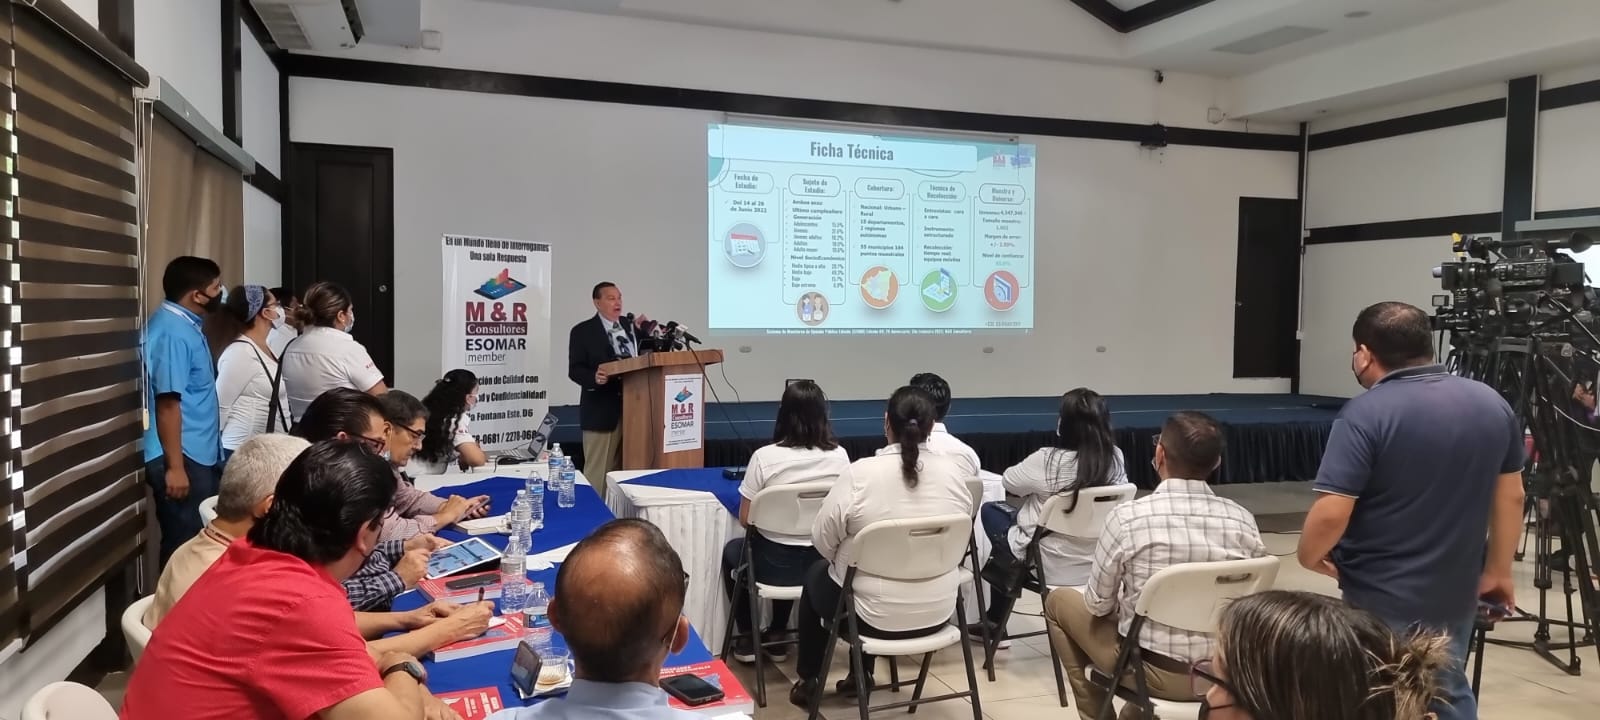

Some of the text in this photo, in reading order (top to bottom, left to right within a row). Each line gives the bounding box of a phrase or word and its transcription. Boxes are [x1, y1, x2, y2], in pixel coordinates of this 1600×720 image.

[810, 141, 894, 161] Ficha Técnica
[734, 173, 759, 182] Fecha de
[803, 178, 820, 186] Sujeto
[735, 181, 757, 189] Estudio:
[867, 184, 894, 192] Cobertura:
[454, 237, 463, 247] un
[463, 237, 484, 248] Mundo
[485, 239, 501, 249] lleno
[501, 240, 510, 249] de
[510, 241, 549, 252] Interrogantes
[470, 251, 527, 264] Una sola Respuesta
[466, 301, 528, 322] M & R
[467, 324, 526, 335] Consultores
[465, 338, 527, 351] ESOMAR
[468, 352, 506, 362] member
[494, 375, 501, 385] de
[503, 374, 525, 385] Calidad
[526, 375, 539, 384] con
[486, 394, 490, 403] y
[477, 411, 506, 421] Fontana
[671, 421, 694, 429] ESOMAR
